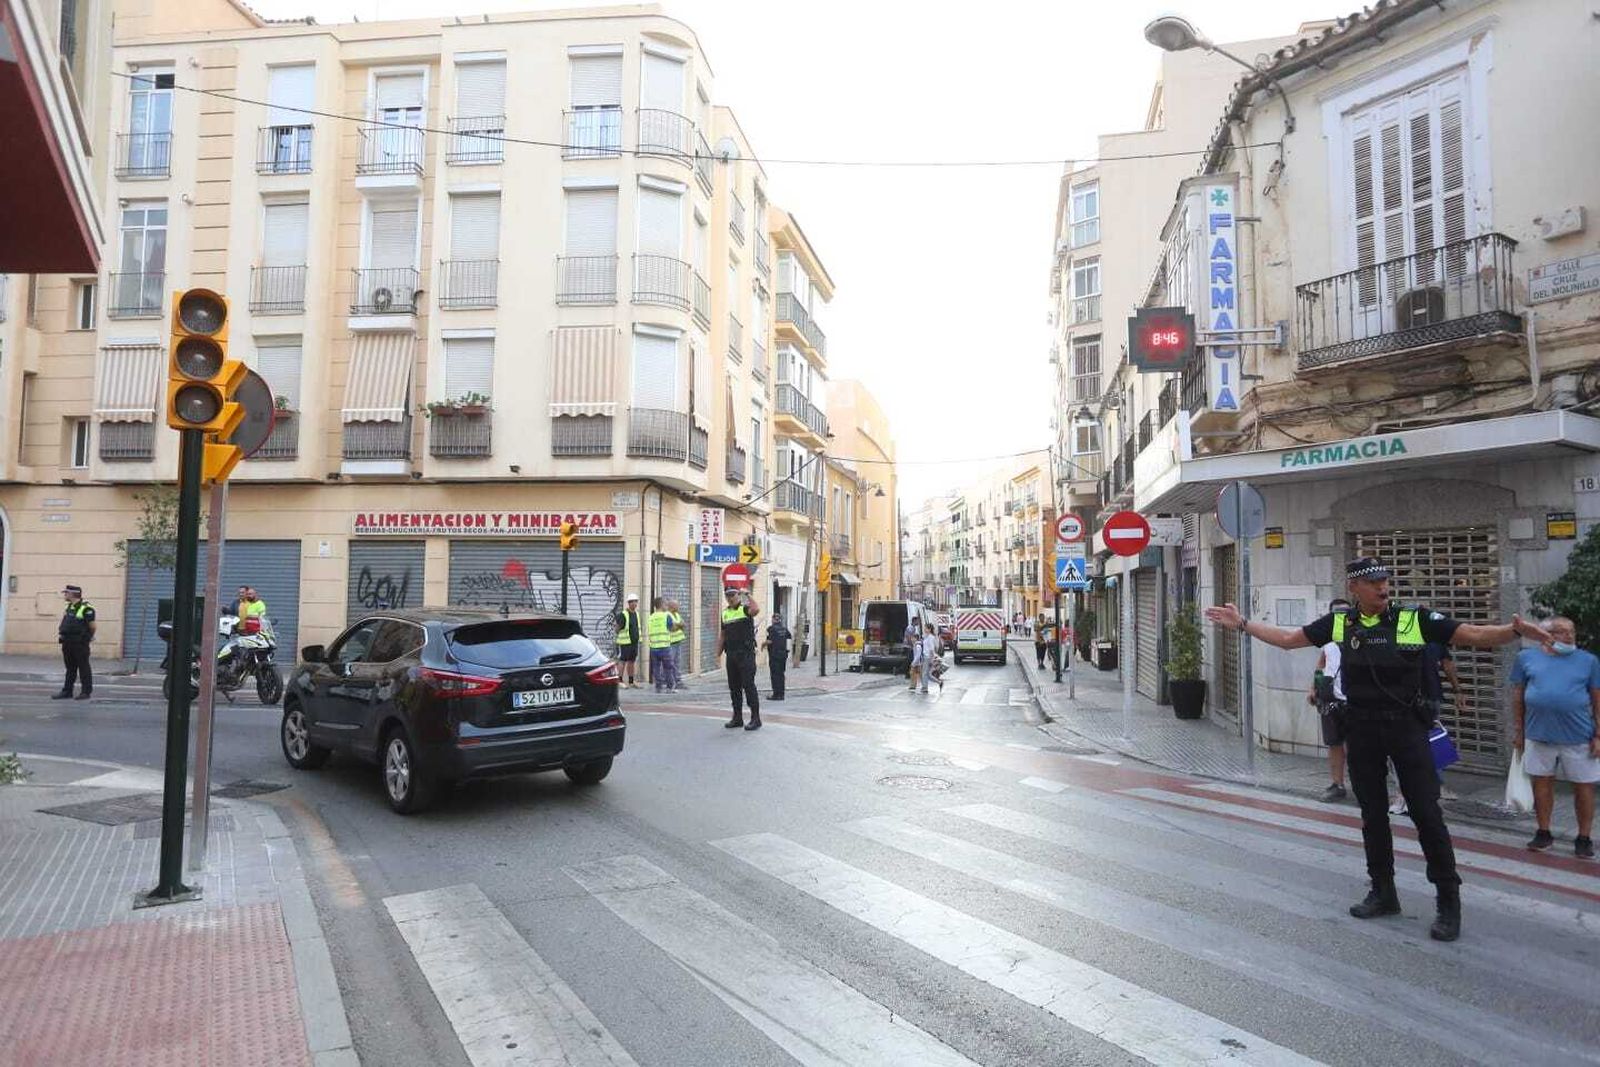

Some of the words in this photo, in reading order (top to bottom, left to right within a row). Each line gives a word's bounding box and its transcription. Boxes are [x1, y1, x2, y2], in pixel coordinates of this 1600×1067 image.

[1553, 273, 1577, 286] CRUZ
[1533, 289, 1549, 299] DEL
[1552, 278, 1599, 295] MOLINILLO
[1209, 213, 1237, 409] FARMACIA
[1152, 332, 1179, 345] 8:46
[1281, 438, 1407, 467] FARMACIA
[1580, 478, 1594, 490] 18
[355, 513, 486, 527] ALIMENTACION
[492, 514, 502, 527] Y
[508, 514, 616, 528] MINIBAZAR
[700, 546, 712, 561] P
[521, 692, 549, 704] 5210
